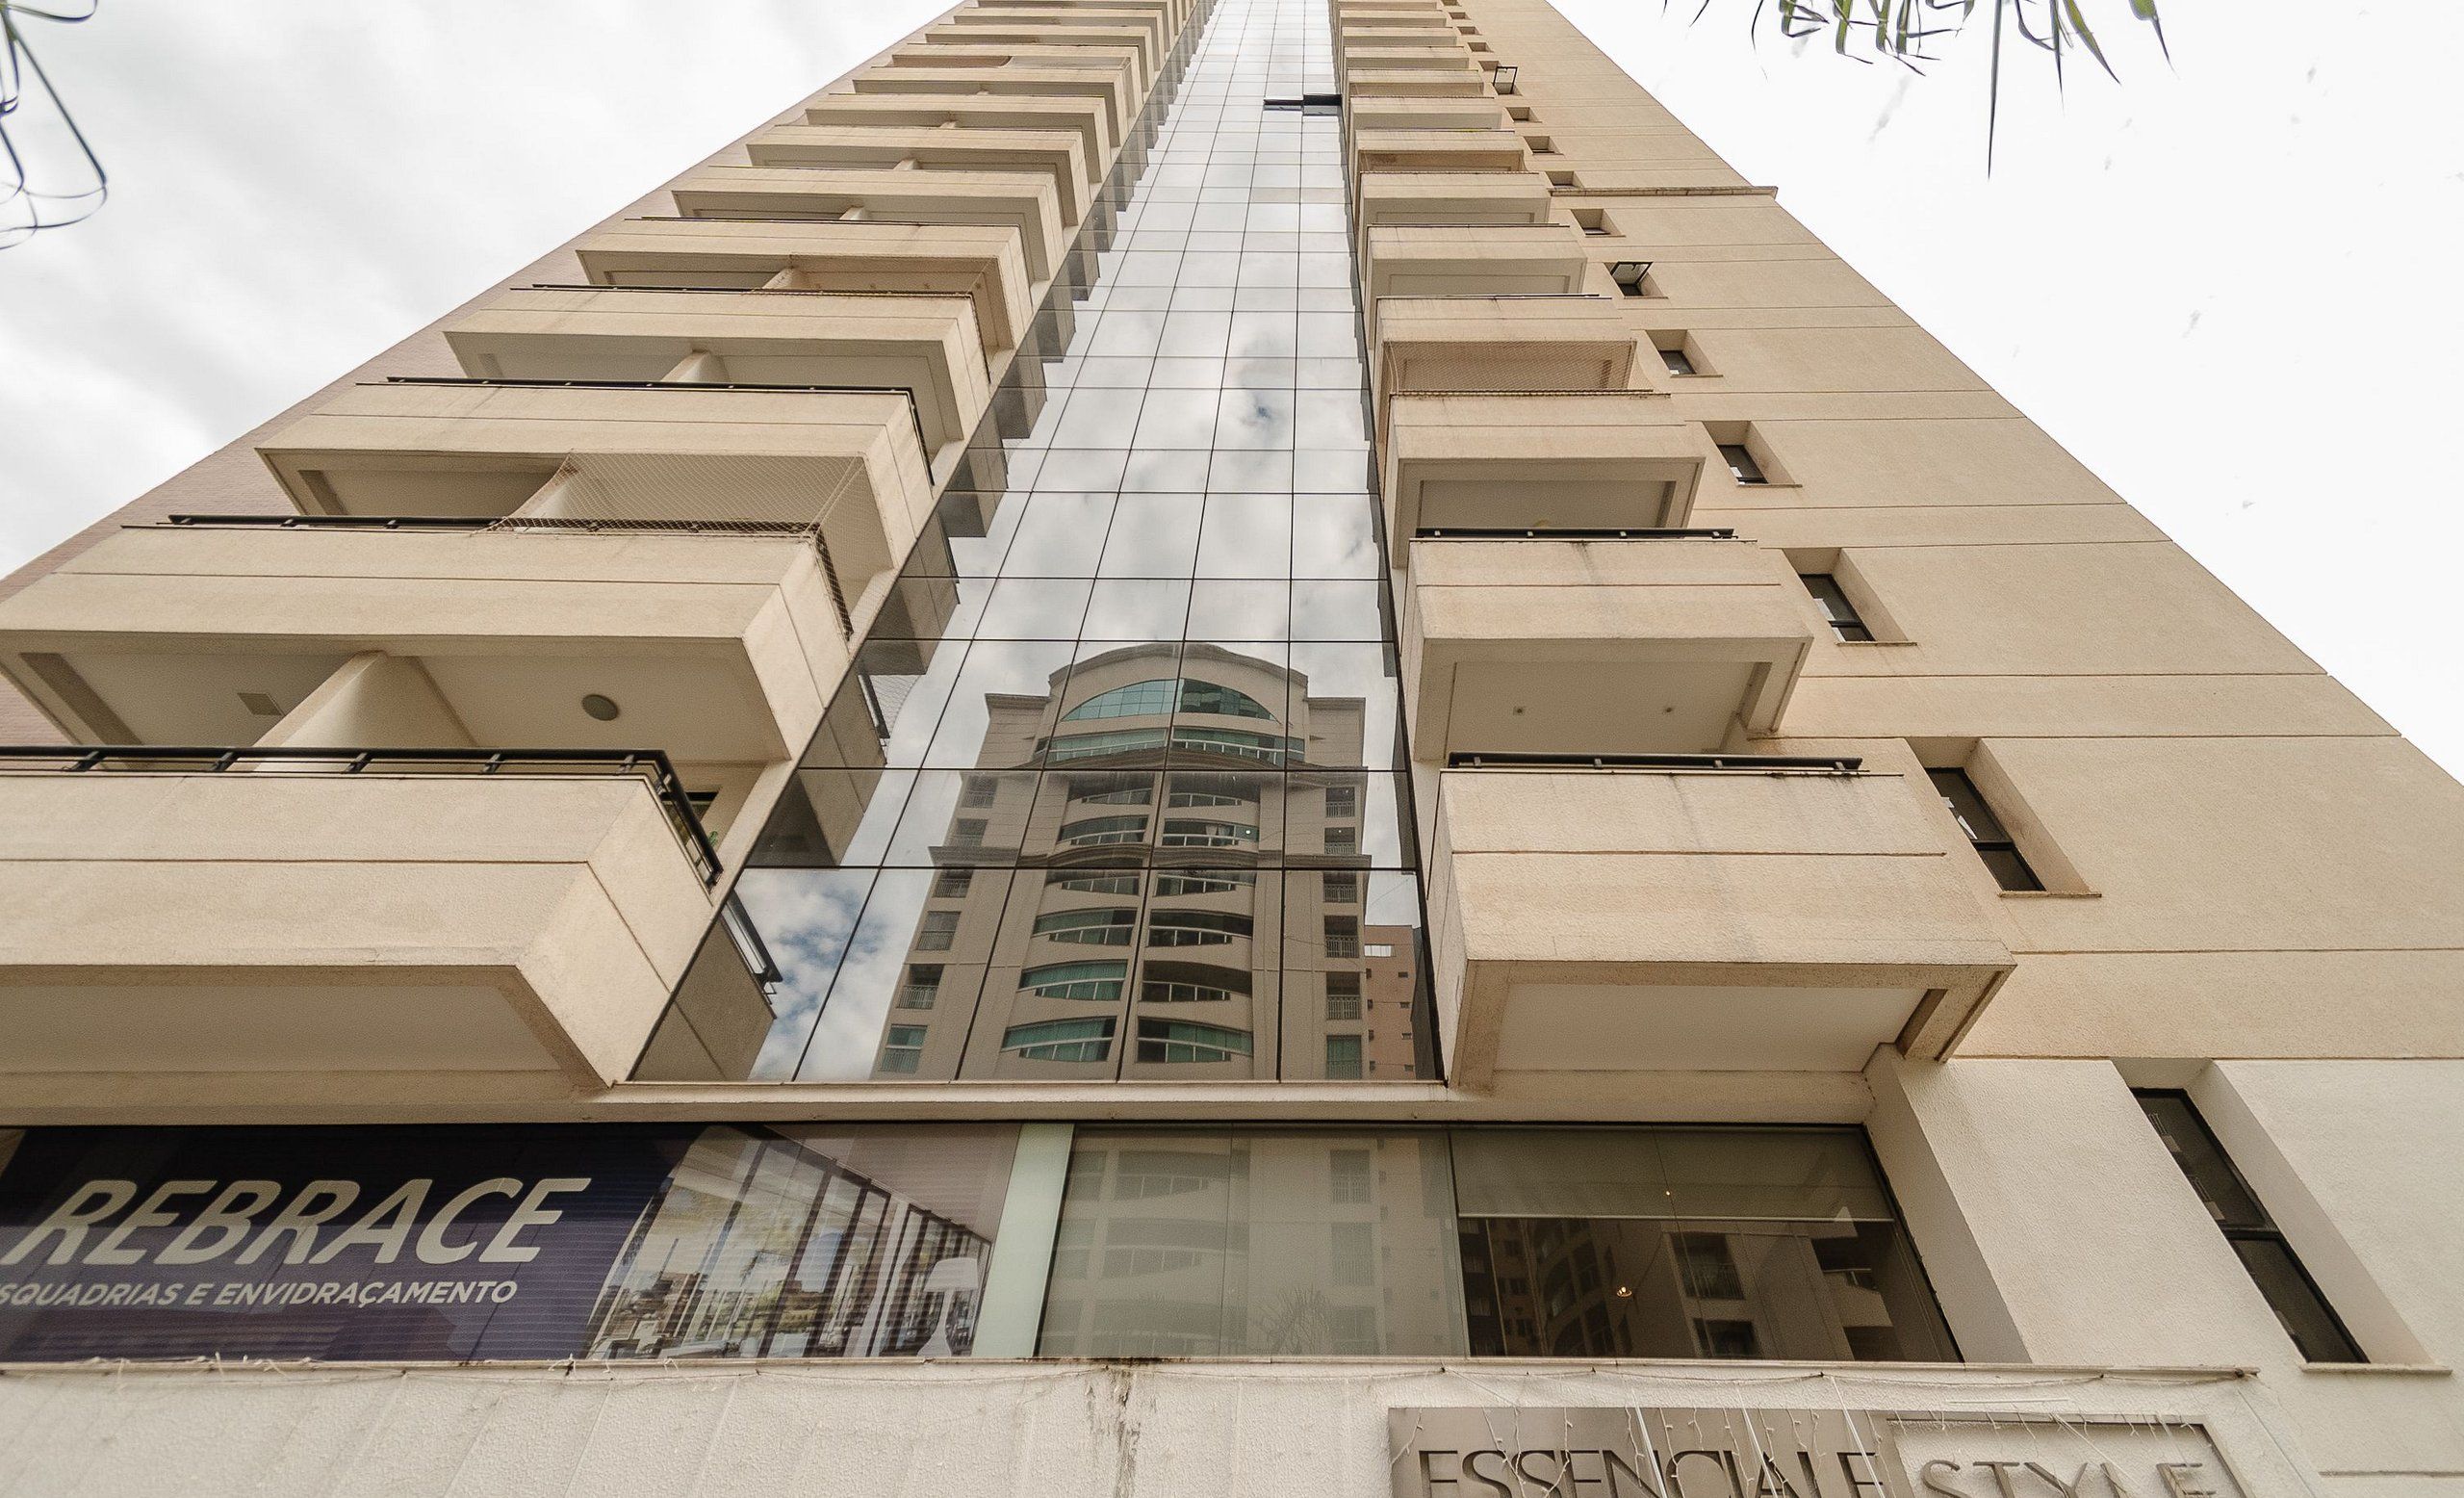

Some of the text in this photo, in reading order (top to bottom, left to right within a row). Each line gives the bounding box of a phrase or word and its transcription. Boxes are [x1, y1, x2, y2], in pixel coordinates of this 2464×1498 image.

[0, 1177, 591, 1265] REBRACE
[183, 1282, 215, 1305] E
[214, 1280, 517, 1308] ENVIDRAÇAMENTO
